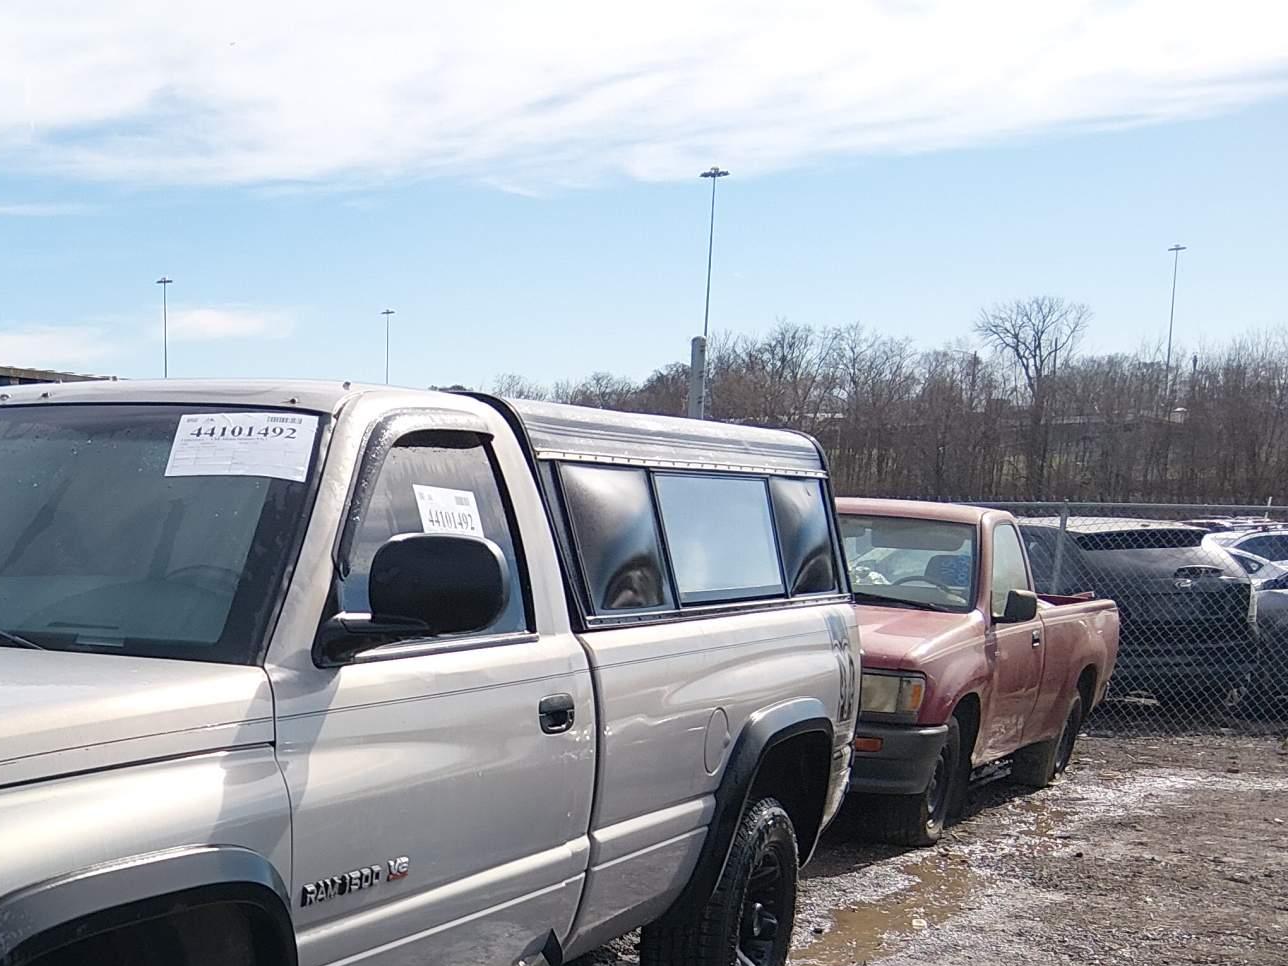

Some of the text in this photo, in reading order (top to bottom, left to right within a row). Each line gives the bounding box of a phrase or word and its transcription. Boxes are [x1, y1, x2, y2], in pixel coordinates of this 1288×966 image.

[190, 425, 297, 439] 44101492
[428, 508, 475, 531] 44101492
[300, 876, 340, 907] RAM
[342, 864, 382, 895] 1500
